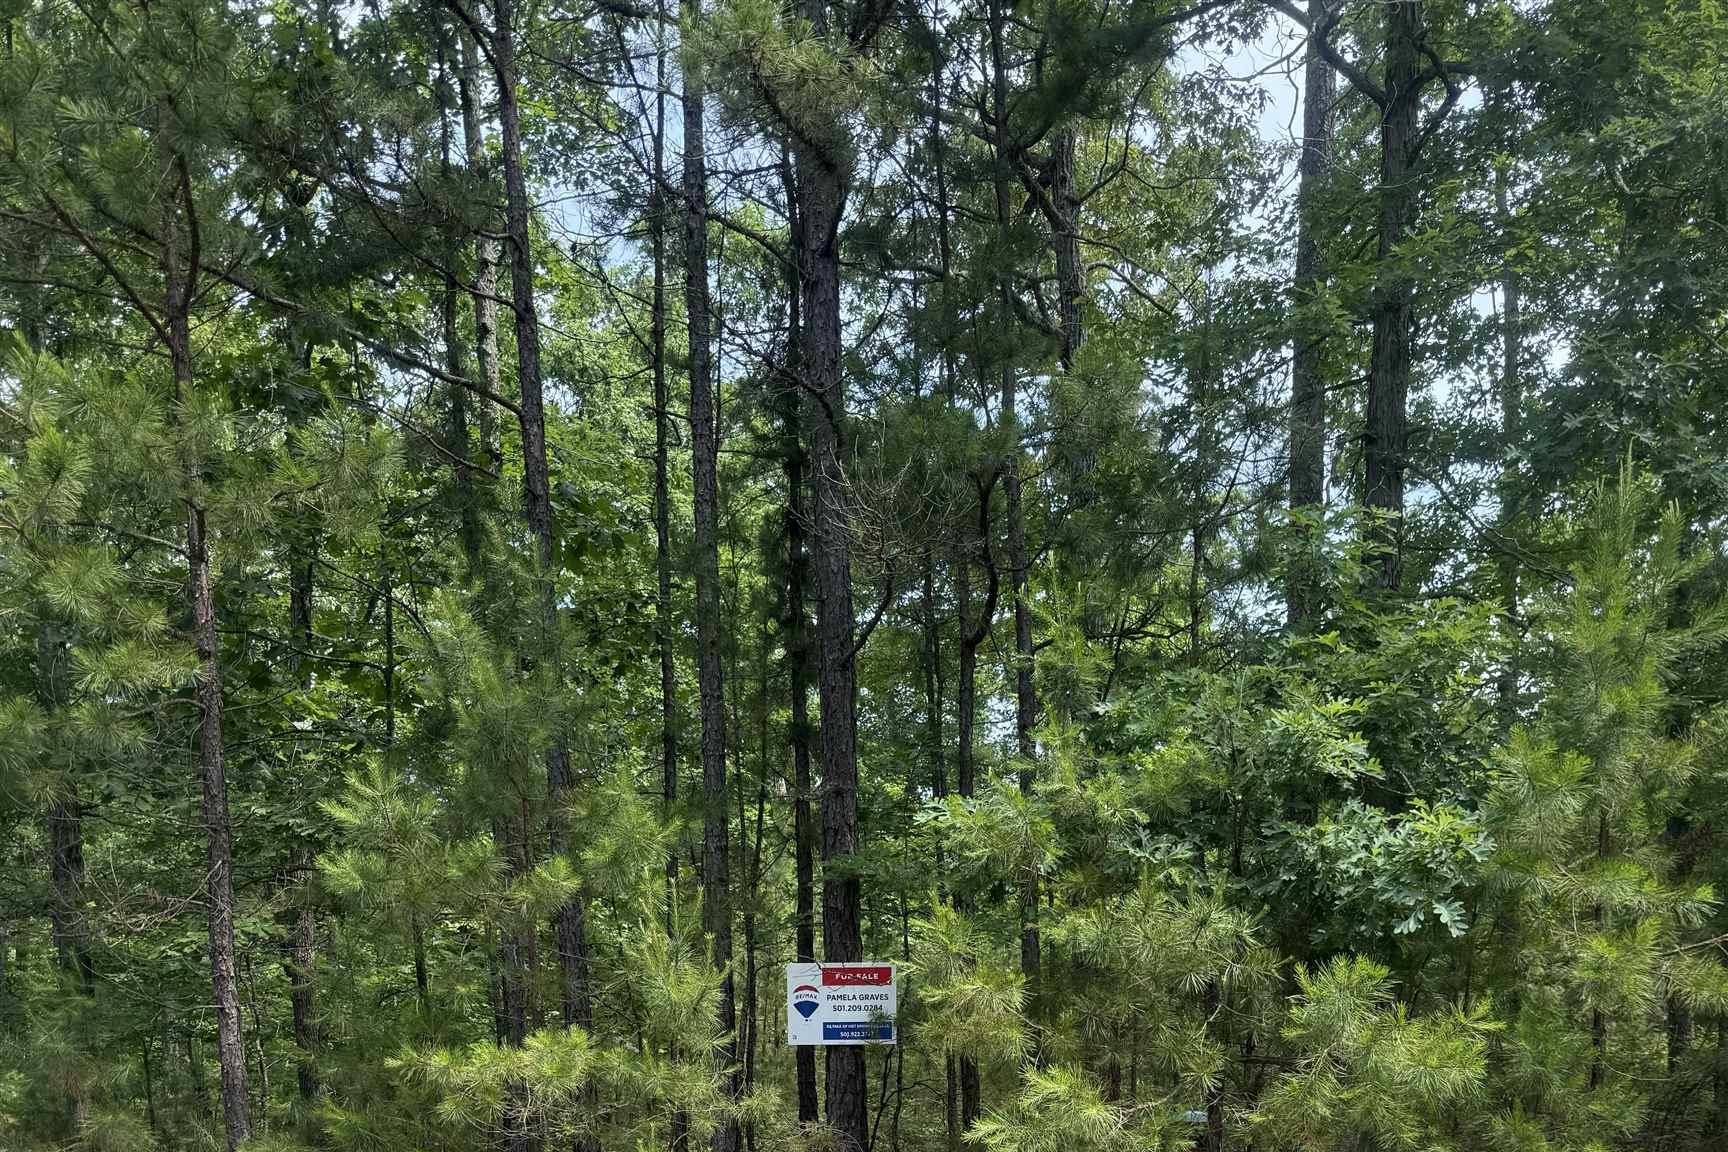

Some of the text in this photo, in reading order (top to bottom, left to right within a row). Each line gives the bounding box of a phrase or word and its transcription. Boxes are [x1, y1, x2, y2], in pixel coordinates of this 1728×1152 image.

[826, 993, 889, 1001] PAMELA GRAVES
[832, 1004, 883, 1012] 501.209.0284
